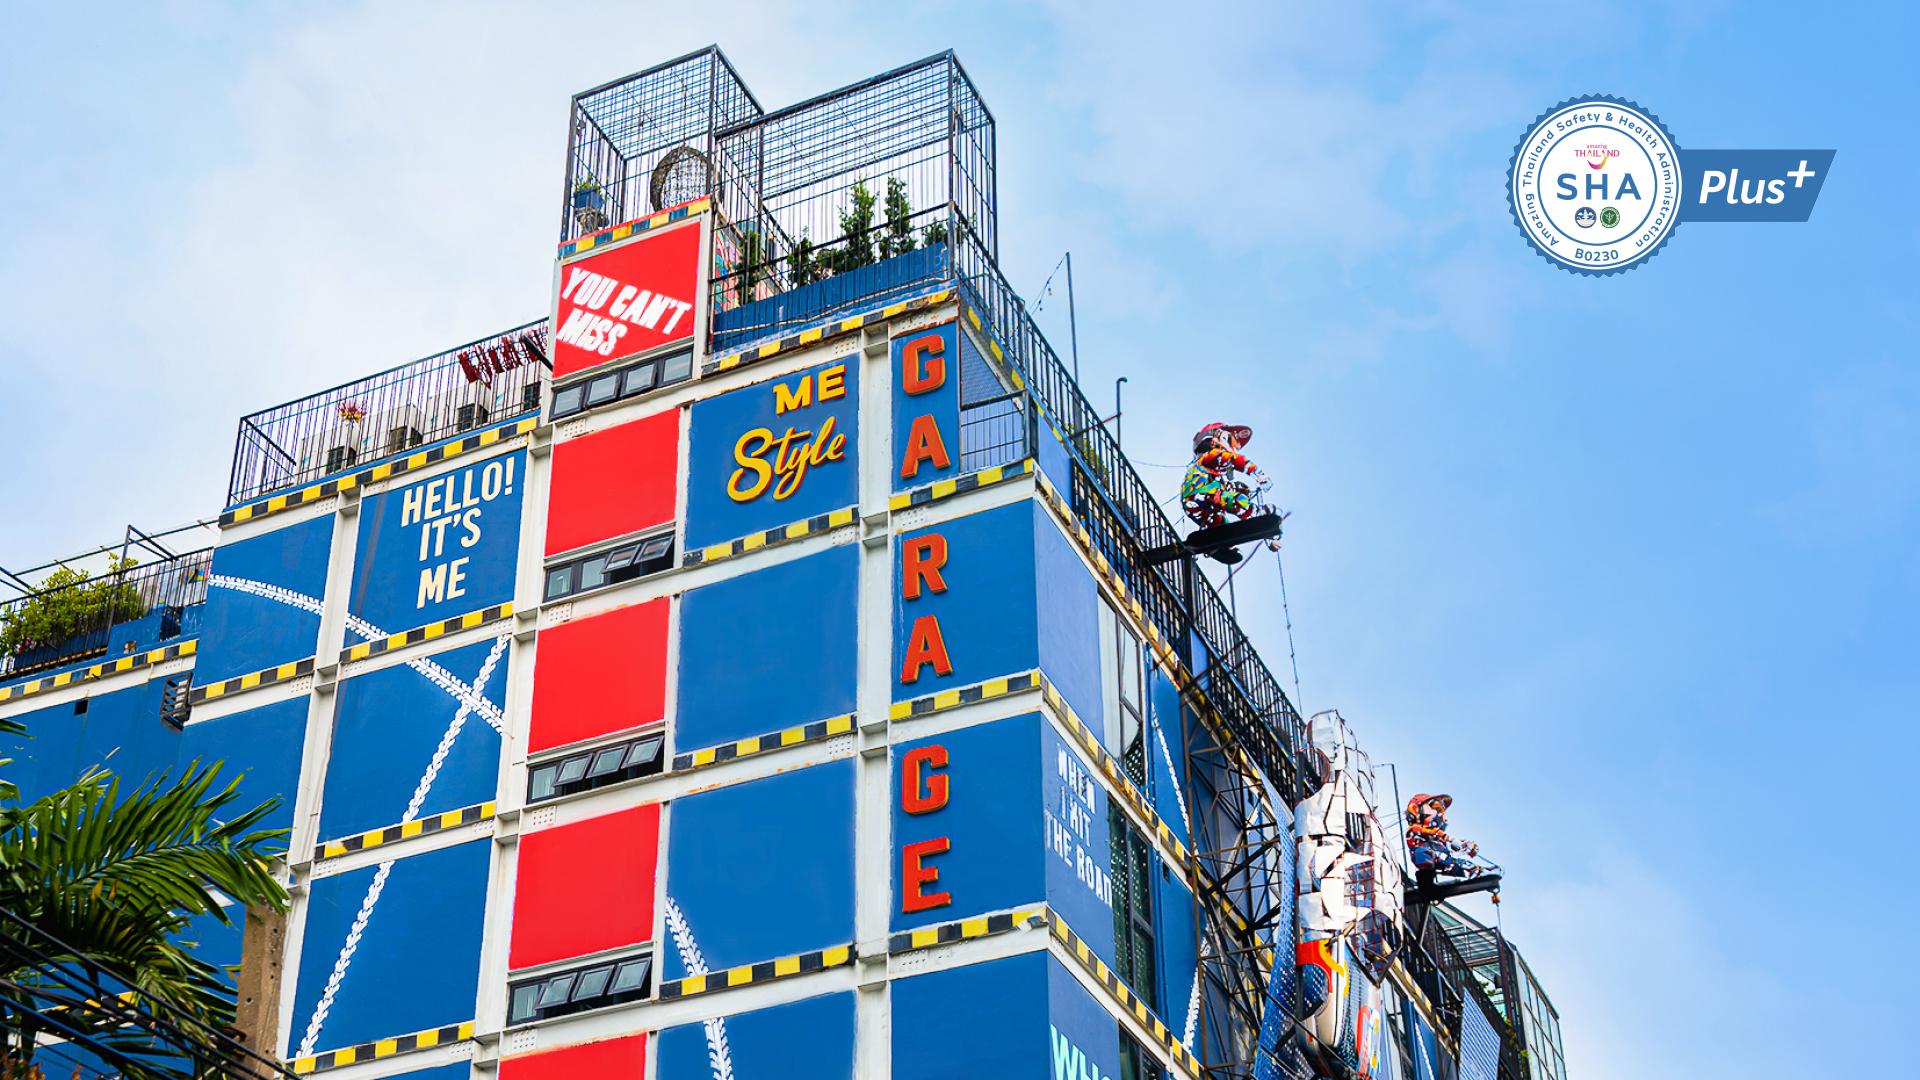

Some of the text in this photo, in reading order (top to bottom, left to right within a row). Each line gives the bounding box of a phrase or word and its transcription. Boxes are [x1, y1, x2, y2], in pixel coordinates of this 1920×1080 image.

[556, 307, 628, 356] MISS
[562, 267, 692, 335] YOU CAN'T
[773, 364, 847, 416] ME
[727, 415, 847, 502] Style
[401, 456, 515, 527] HELLO!
[419, 507, 482, 561] IT'S
[417, 556, 470, 609] ME
[1057, 744, 1096, 814] WHEN
[1061, 786, 1092, 847] I HIT
[1045, 809, 1113, 908] THE ROAD
